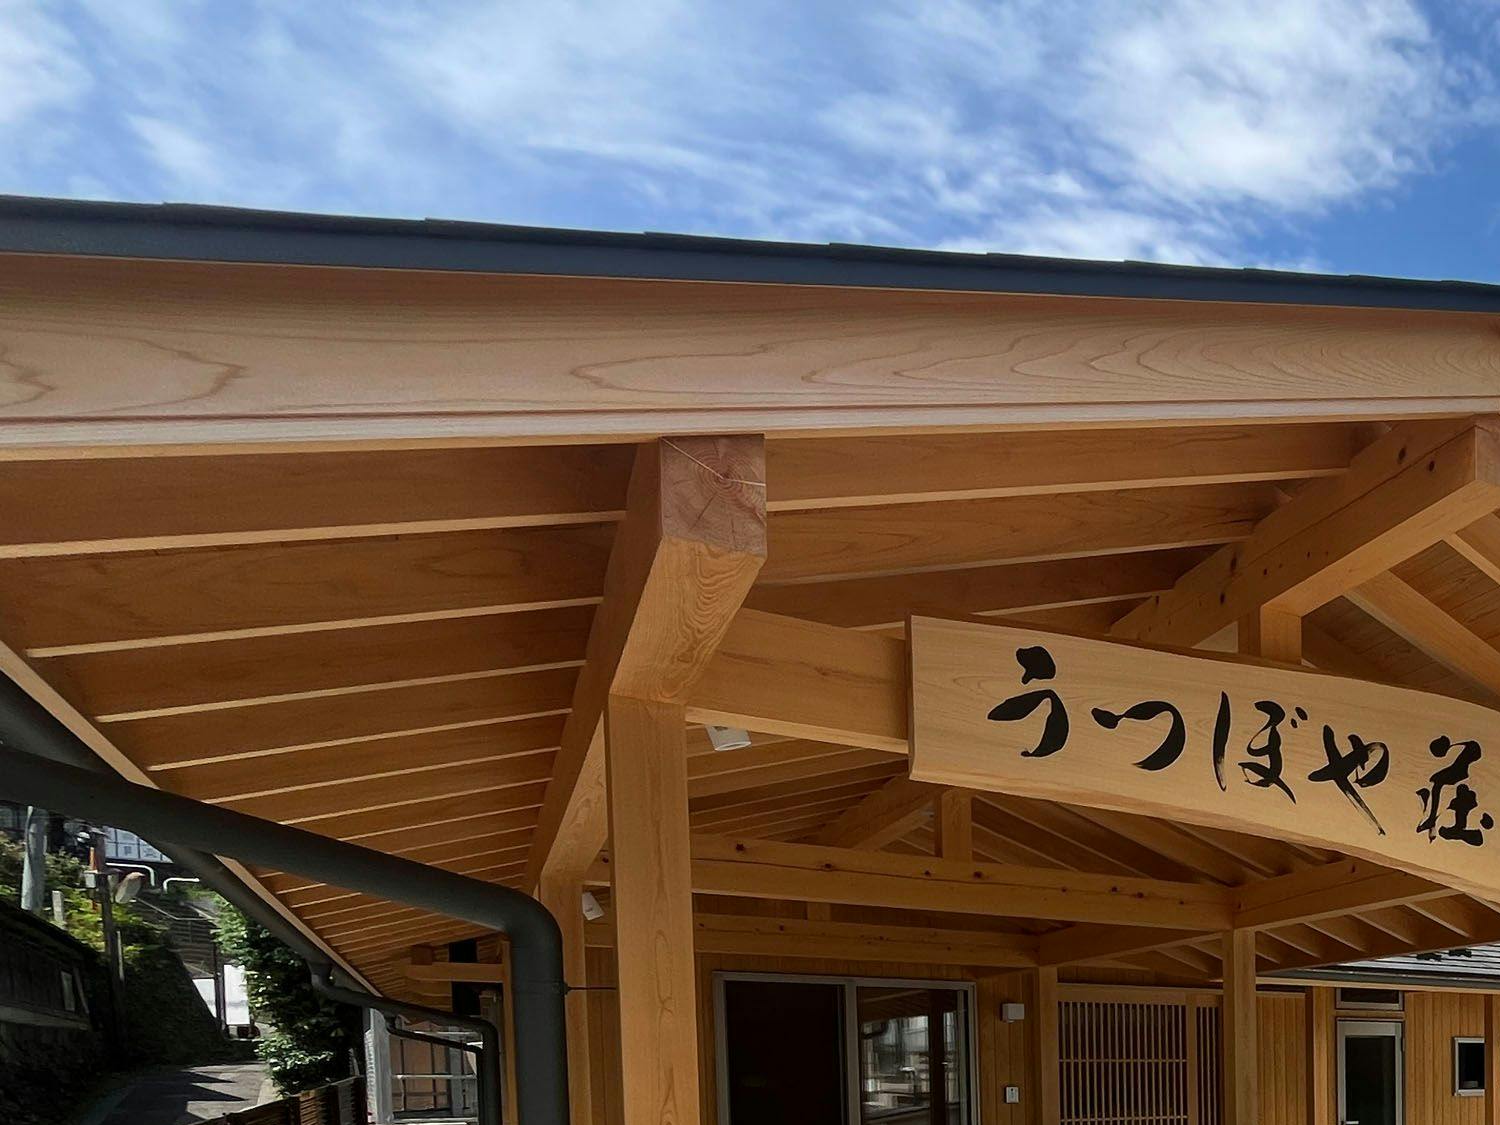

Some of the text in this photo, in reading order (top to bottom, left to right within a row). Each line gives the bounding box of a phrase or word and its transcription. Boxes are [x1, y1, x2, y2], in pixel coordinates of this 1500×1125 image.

[988, 645, 1494, 847] うつぼや荘
